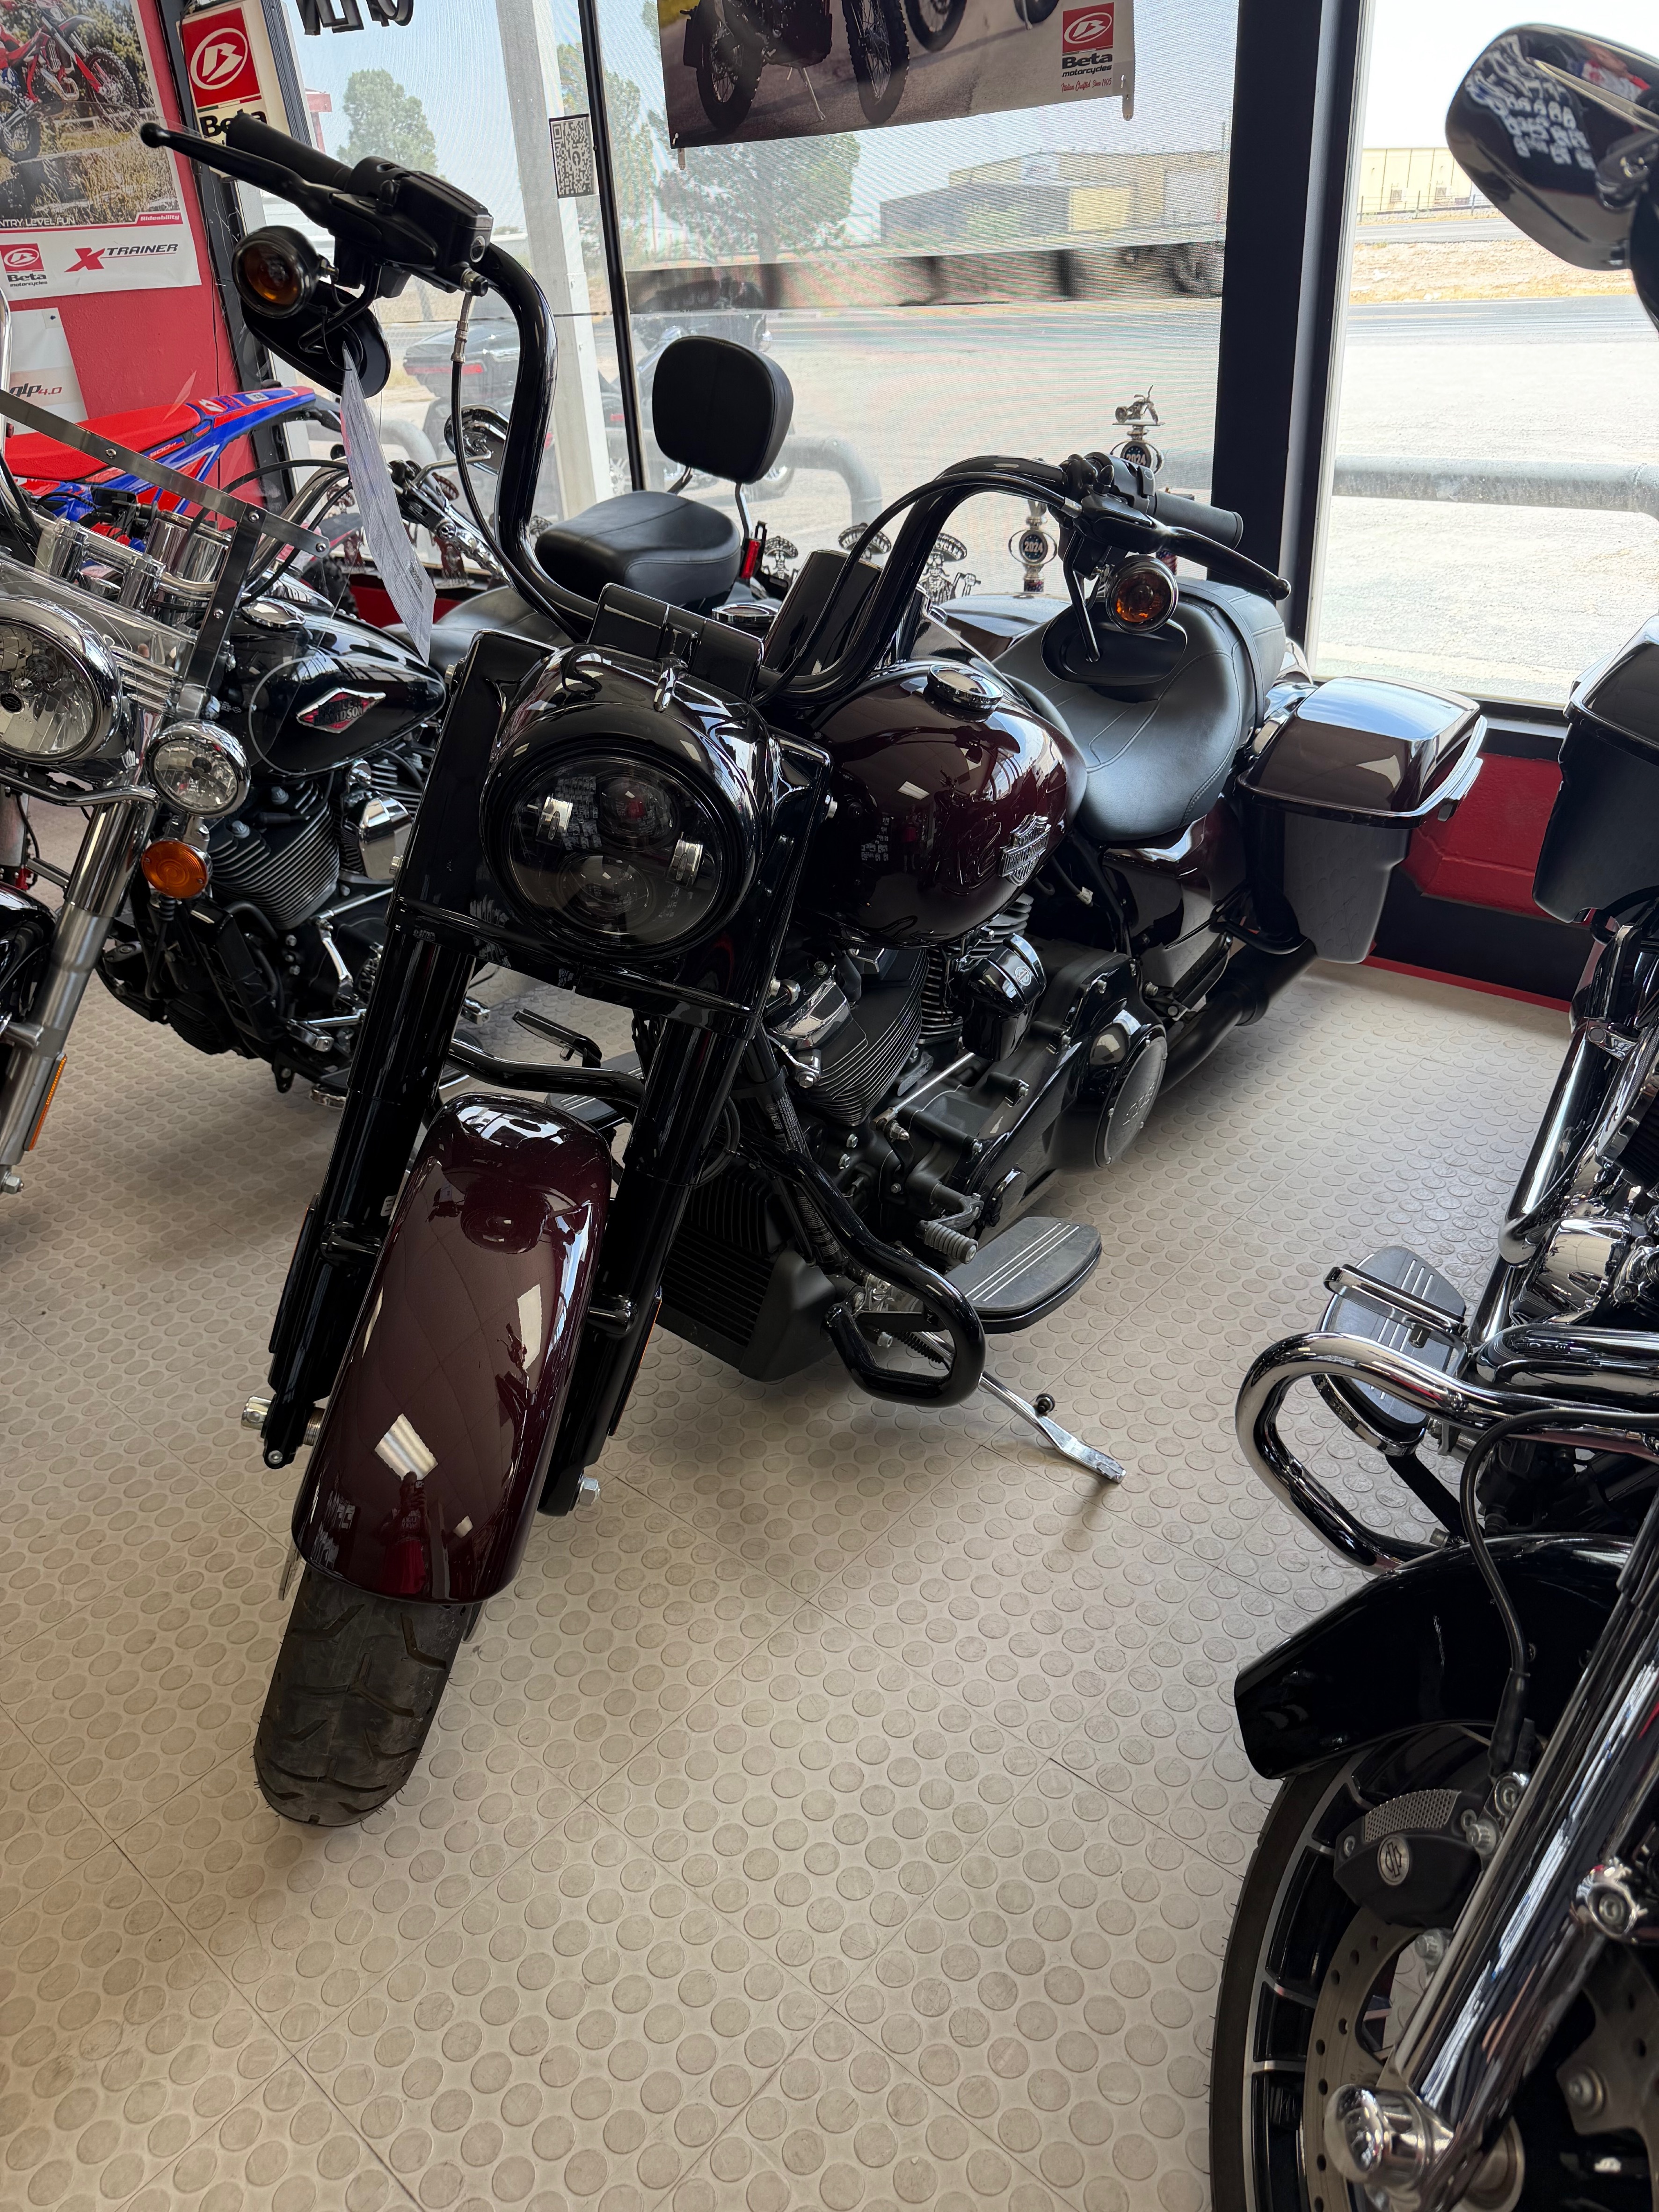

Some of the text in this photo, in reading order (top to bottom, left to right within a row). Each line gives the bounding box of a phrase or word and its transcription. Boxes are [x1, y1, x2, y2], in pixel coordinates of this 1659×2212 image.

[1062, 52, 1113, 69] Beta
[1062, 65, 1112, 77] motorcycles
[1102, 78, 1112, 86] 1905
[26, 217, 55, 226] LEVEL
[57, 216, 75, 225] FUN
[7, 273, 47, 282] Beta
[1126, 453, 1146, 466] 2024
[1024, 541, 1043, 553] 2024
